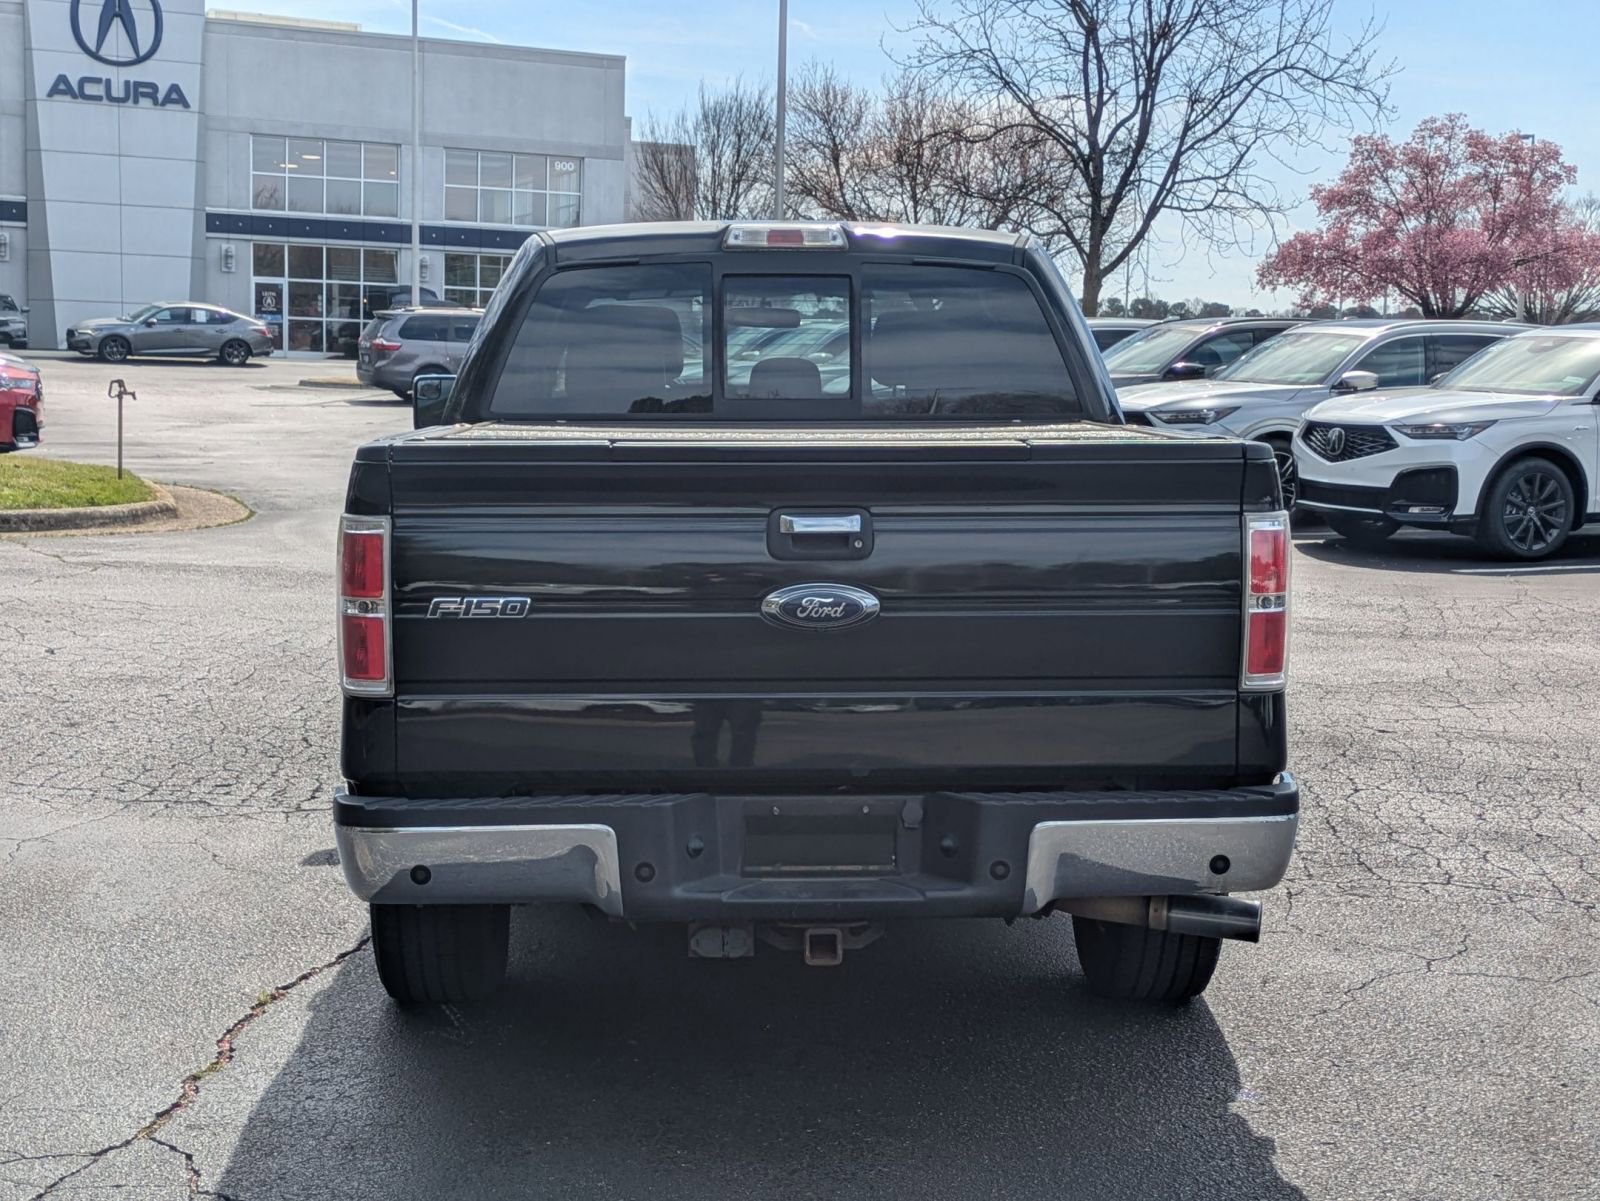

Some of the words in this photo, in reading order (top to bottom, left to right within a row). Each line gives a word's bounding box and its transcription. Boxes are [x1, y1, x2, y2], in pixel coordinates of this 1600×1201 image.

[46, 74, 191, 109] ACURA
[554, 161, 575, 171] 900
[427, 597, 531, 618] F-150
[796, 597, 846, 618] Ford
